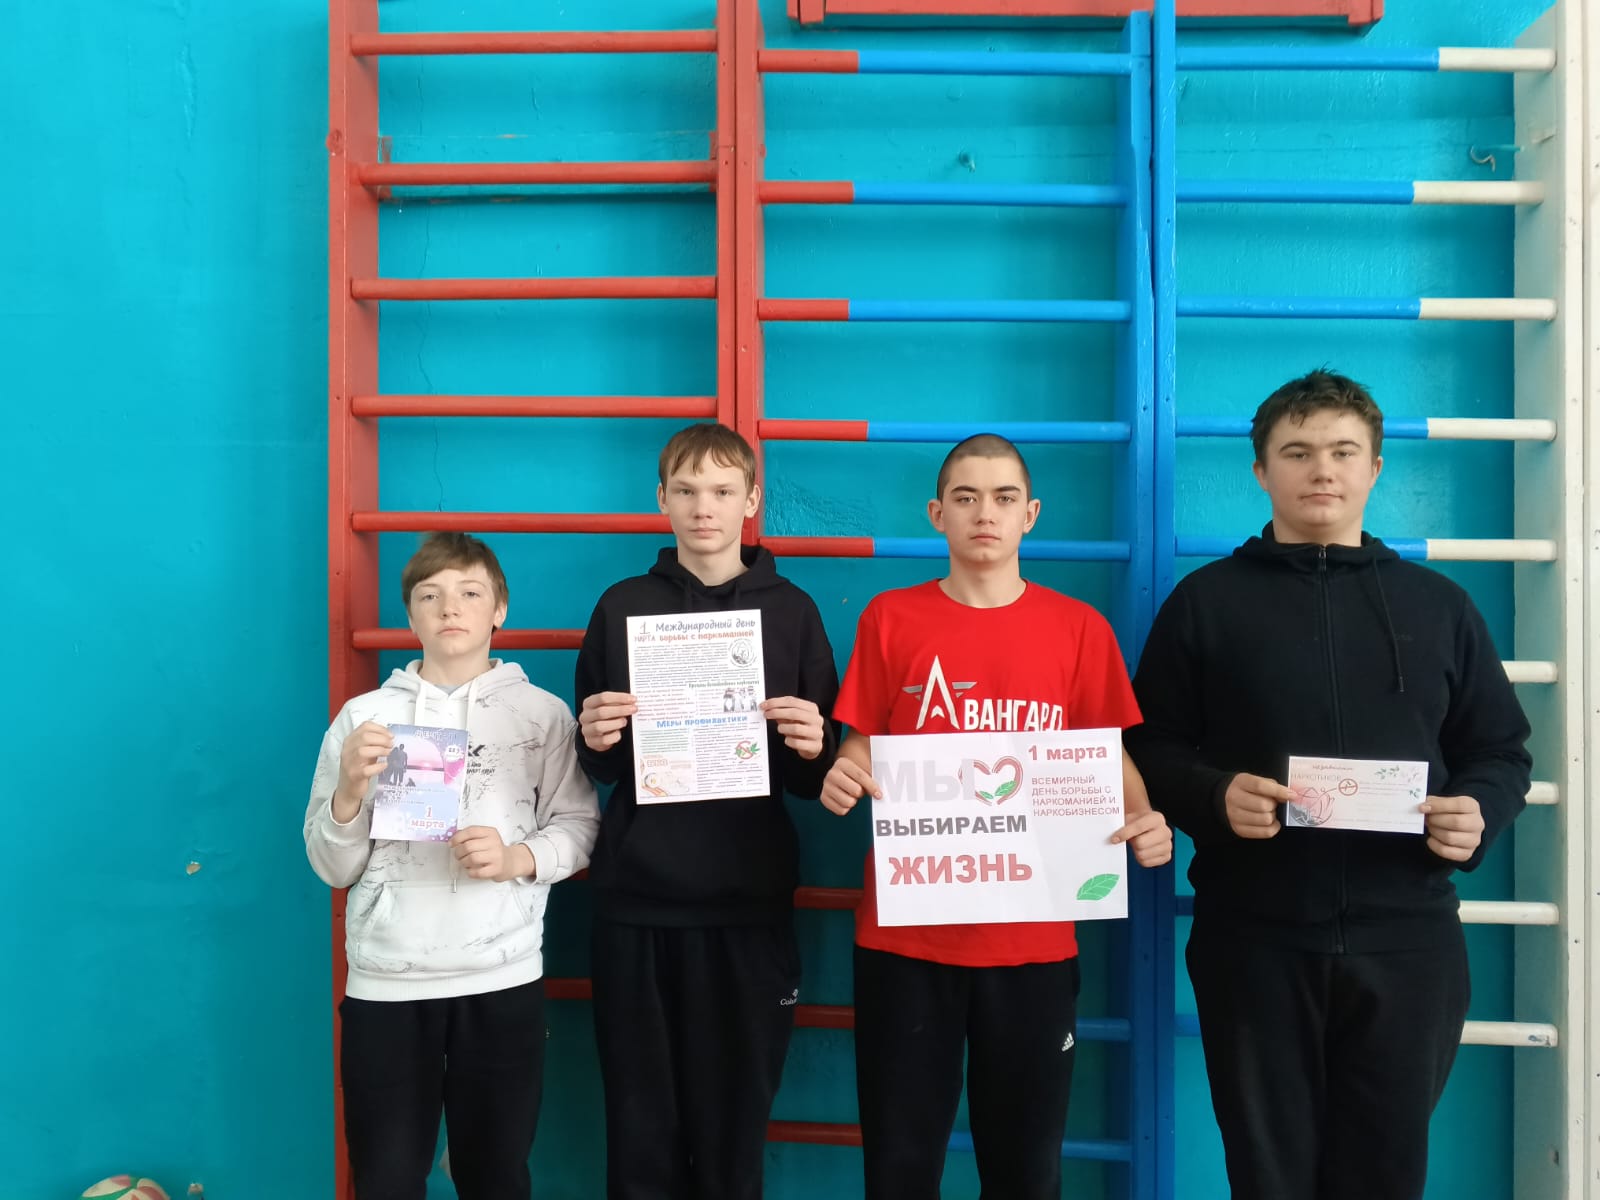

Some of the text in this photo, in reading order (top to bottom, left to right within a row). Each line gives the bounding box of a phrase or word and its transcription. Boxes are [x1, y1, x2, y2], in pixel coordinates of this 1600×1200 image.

[656, 618, 755, 633] Международный день
[1028, 745, 1107, 763] 1 марта
[873, 758, 976, 804] МЫ
[1031, 775, 1095, 785] ВСЕМИРНЫЙ
[1031, 786, 1111, 797] ДЕНЬ БОРЬБЫ С
[1032, 796, 1116, 806] НАРКОМАНИЕЙ И
[1033, 806, 1120, 817] НАРКОБИЗНЕСОМ
[411, 821, 445, 829] марта
[875, 815, 1027, 837] ВЫБИРАЕМ
[888, 853, 1033, 885] ЖИЗНЬ
